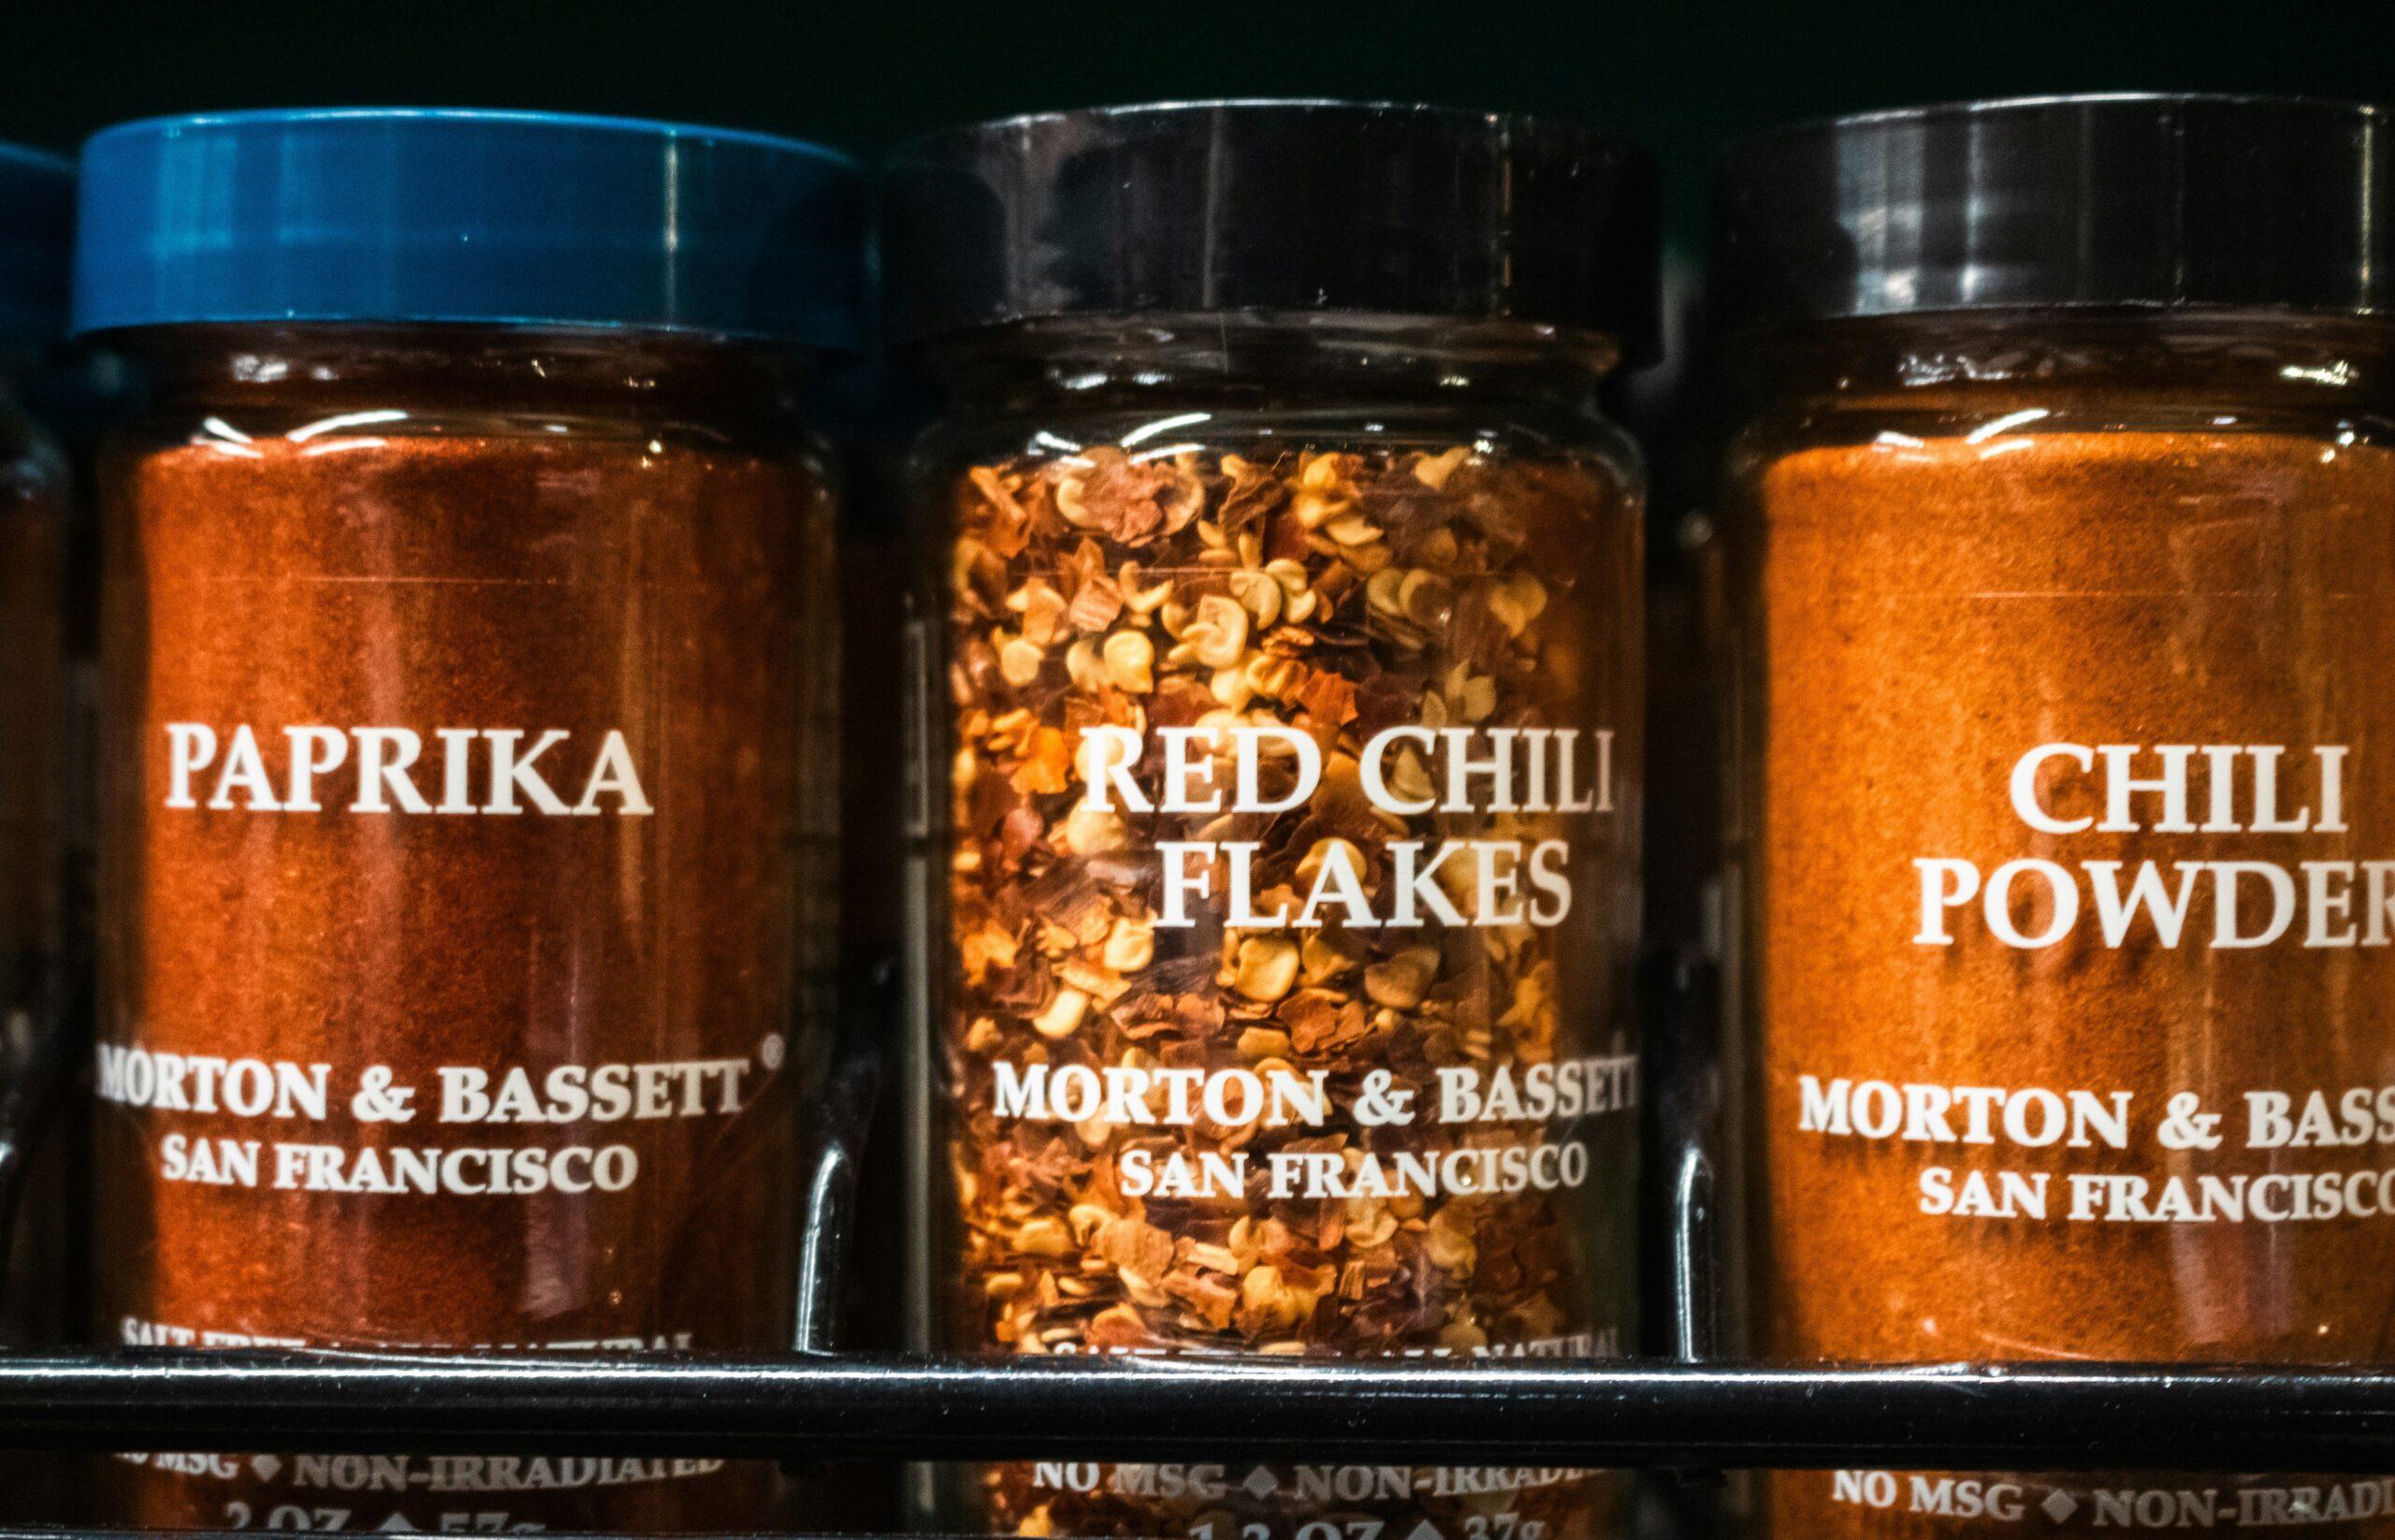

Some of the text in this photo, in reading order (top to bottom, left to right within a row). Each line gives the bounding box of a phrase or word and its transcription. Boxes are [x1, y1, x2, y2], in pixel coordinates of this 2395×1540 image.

[165, 722, 654, 815] PAPRIKA
[1078, 724, 1615, 814] RED CHILI
[2010, 743, 2349, 834] CHILI
[1154, 840, 1572, 927] FLAKES
[1912, 857, 2395, 949] POWDER
[96, 1042, 331, 1121] MORTON
[352, 1065, 416, 1123] &
[993, 1060, 1330, 1127] MORTON
[1354, 1068, 1415, 1126] &
[1798, 1075, 2133, 1149] MORTON
[2157, 1091, 2223, 1150] &
[160, 1132, 639, 1195] SAN FRANCISCO
[1122, 1141, 1589, 1199] SAN FRANCISCO
[1919, 1167, 2051, 1220] SAN
[1032, 1461, 1100, 1491] NO
[1111, 1463, 1226, 1497] MSG
[1832, 1469, 1897, 1508] NO
[1909, 1475, 2025, 1522] MSG
